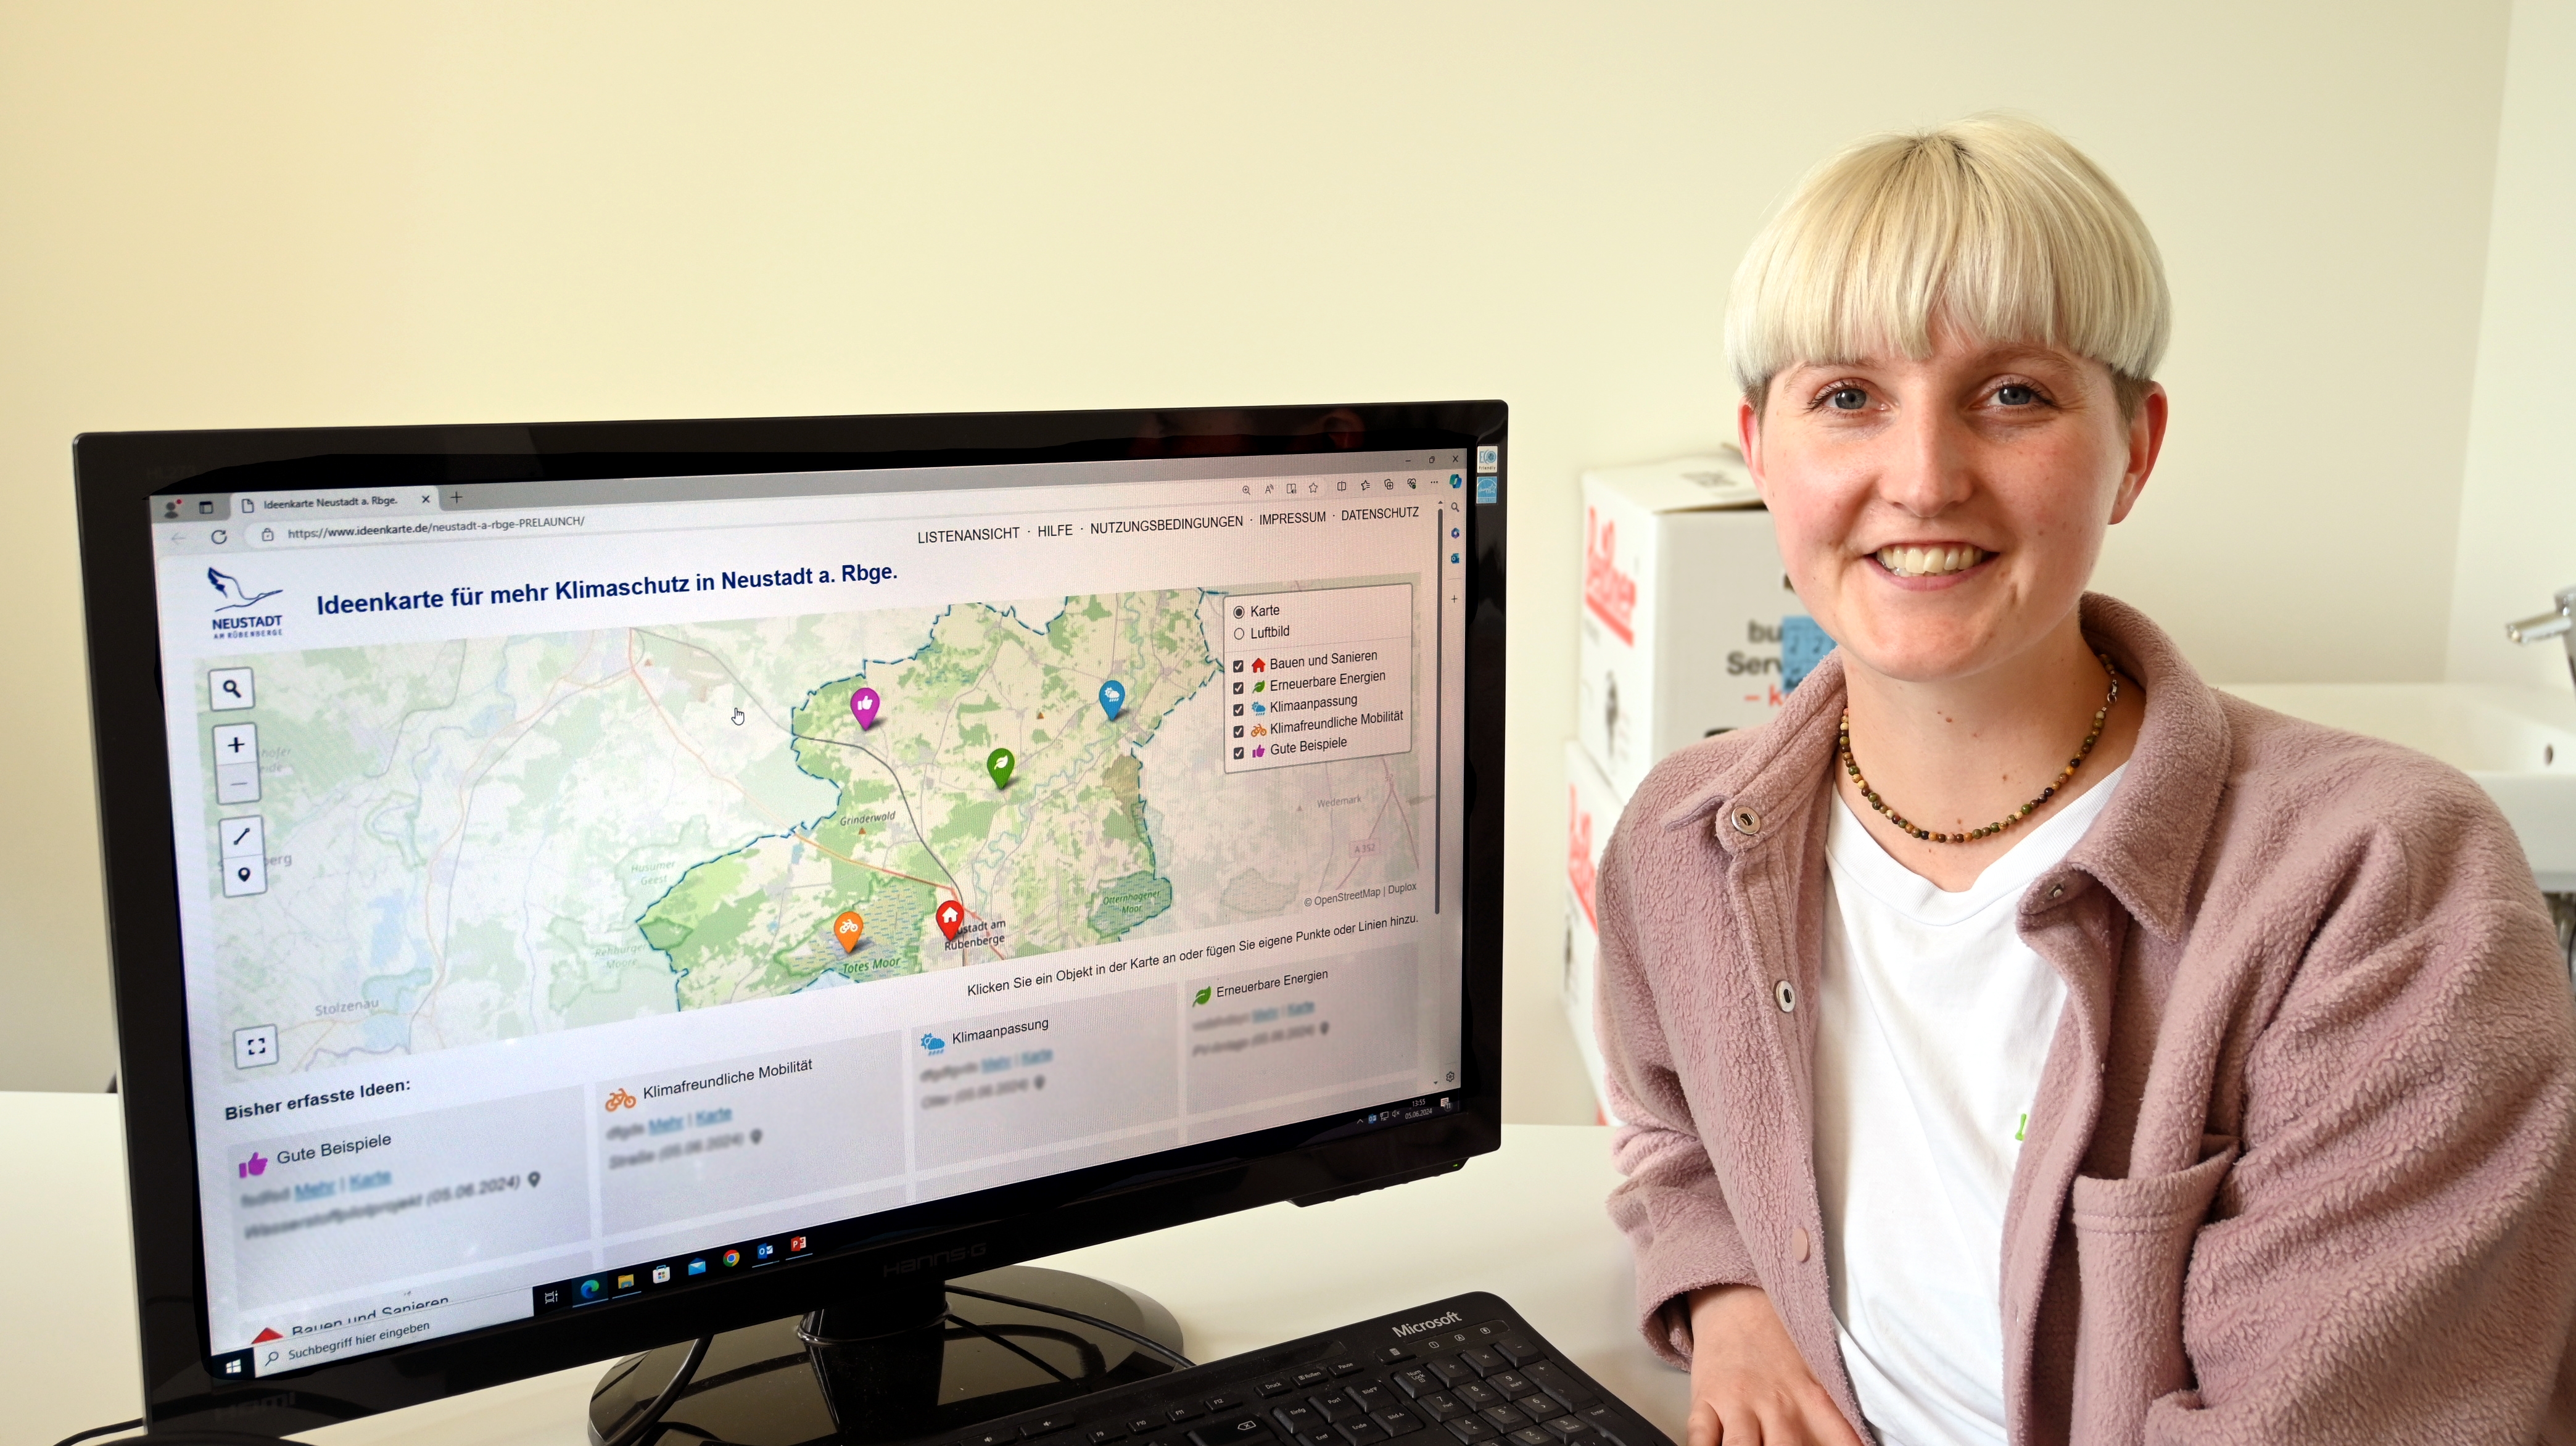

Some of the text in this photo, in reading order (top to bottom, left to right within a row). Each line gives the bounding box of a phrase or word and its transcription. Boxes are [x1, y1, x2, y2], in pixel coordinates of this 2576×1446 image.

[263, 498, 313, 510] Ideenkarte
[317, 497, 358, 508] Neustadt
[372, 495, 398, 508] Rbge.
[288, 515, 585, 540] https://www.ideenkarte.de/neustadt-a-rbge-PRELAUNCH/
[918, 506, 1419, 544] LISTENANSICHT HILFE NUTZUNGSBEDINGUNGEN IMPRESSUM DATENSCHUTZ
[317, 564, 898, 616] Ideenkarte für mehr Klimaschutz in Neustadt a. Rbge.
[1251, 605, 1280, 617] Karte
[213, 615, 283, 630] NEUSTADT
[1251, 625, 1290, 639] Luftbild
[1270, 651, 1377, 670] Bauen und Sanieren
[1270, 671, 1385, 692] Erneuerbare Energien
[1270, 695, 1358, 713] Klimaanpassung
[1270, 710, 1403, 735] Klimafreundliche Mobilität
[1270, 737, 1347, 755] Gute Beispiele
[1317, 794, 1361, 808] Wedemark
[840, 811, 896, 827] Grinderwald
[1363, 843, 1376, 852] 352
[641, 875, 667, 886] Geest
[1315, 888, 1381, 906] OpenStreetMap
[1388, 883, 1417, 894] Duplox
[1122, 906, 1141, 914] Moor
[991, 920, 1005, 930] am
[945, 935, 1005, 951] Rübenberge
[968, 914, 1419, 996] Klicken Sie ein Objekt in der Karte an oder fügen Sie eigene Punkte oder Linien hinzu.
[843, 957, 901, 974] Totes Moor
[1216, 969, 1329, 998] Erneuerbare Energien
[315, 998, 379, 1017] Stolzenau
[952, 1018, 1049, 1044] Klimaanpassung
[643, 1059, 812, 1099] Klimafreundliche Mobilität
[226, 1079, 411, 1121] Bisher erfasste Ideen:
[1412, 1099, 1426, 1107] 13:55
[1405, 1108, 1432, 1120] 05.06.2024
[277, 1133, 392, 1165] Gute Beispiele
[1392, 1311, 1463, 1337] Microsoft
[289, 1323, 429, 1360] Suchbegriff hier eingeben
[1304, 1371, 1321, 1379] Rollen
[1265, 1381, 1282, 1390] Druck
[1352, 1422, 1367, 1430] Ende
[1316, 1433, 1329, 1441] Entf
